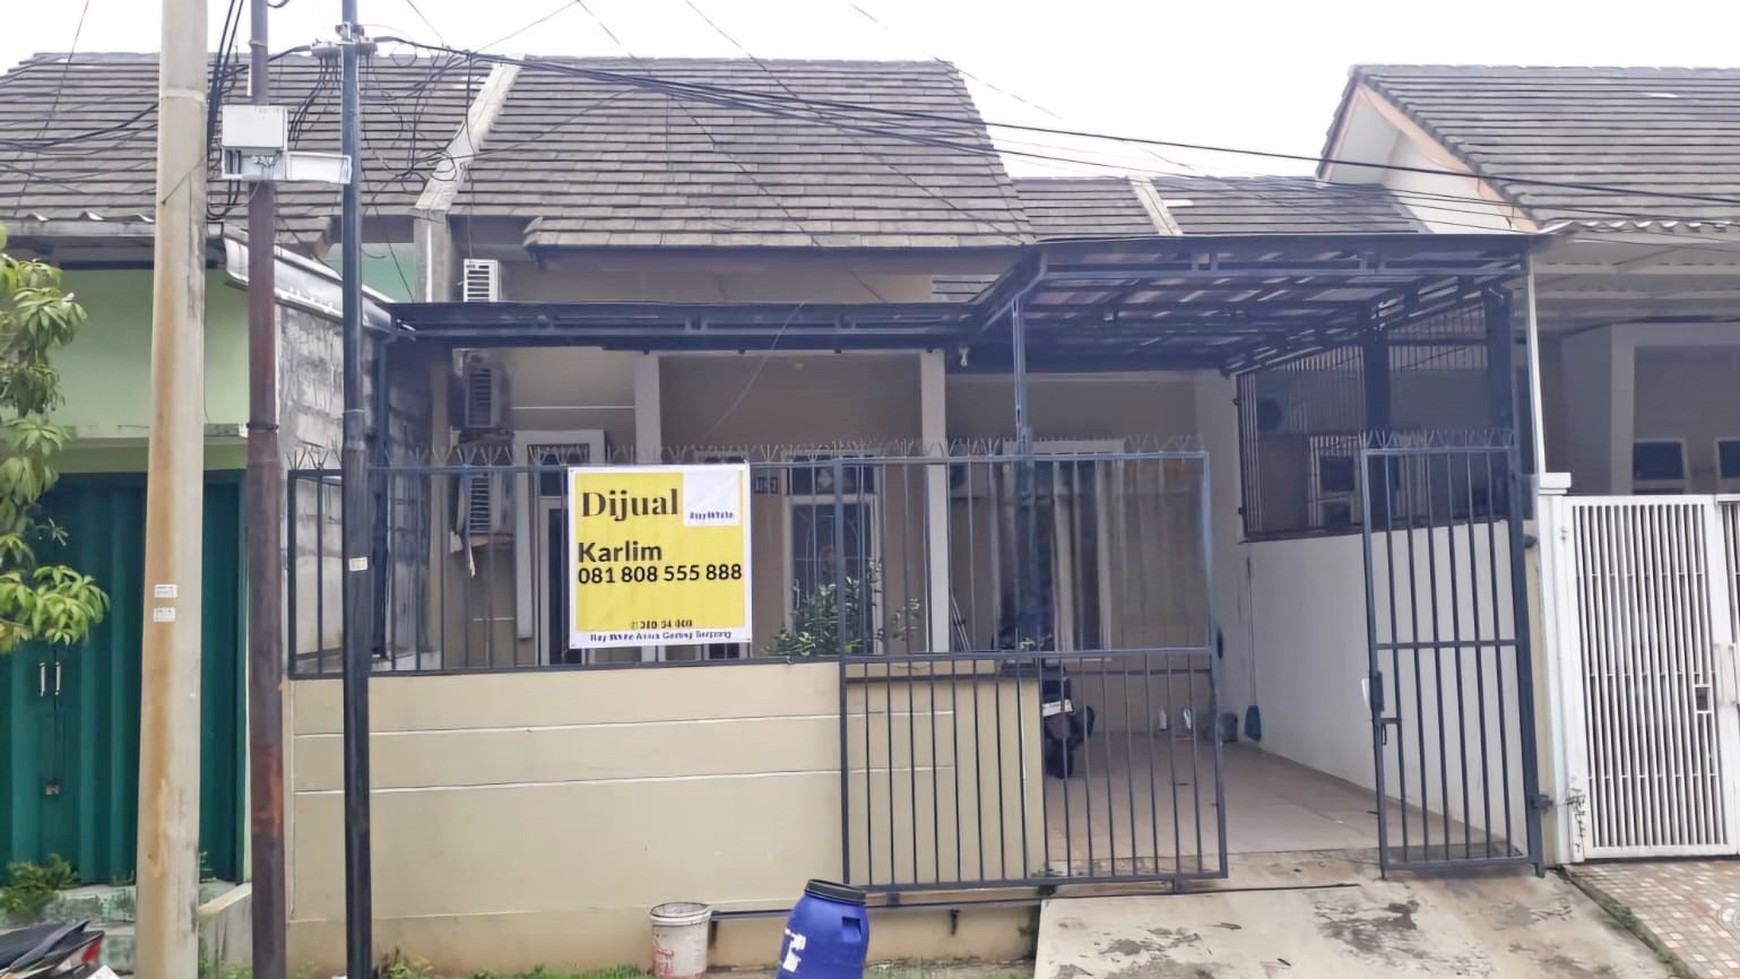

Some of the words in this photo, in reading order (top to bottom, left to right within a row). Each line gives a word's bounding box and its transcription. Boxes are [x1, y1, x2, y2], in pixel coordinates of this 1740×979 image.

[582, 488, 679, 522] Dijual
[578, 540, 662, 564] Karlim
[578, 567, 615, 584] 081
[621, 565, 658, 583] 808
[664, 564, 700, 582] 555
[706, 563, 742, 581] 888
